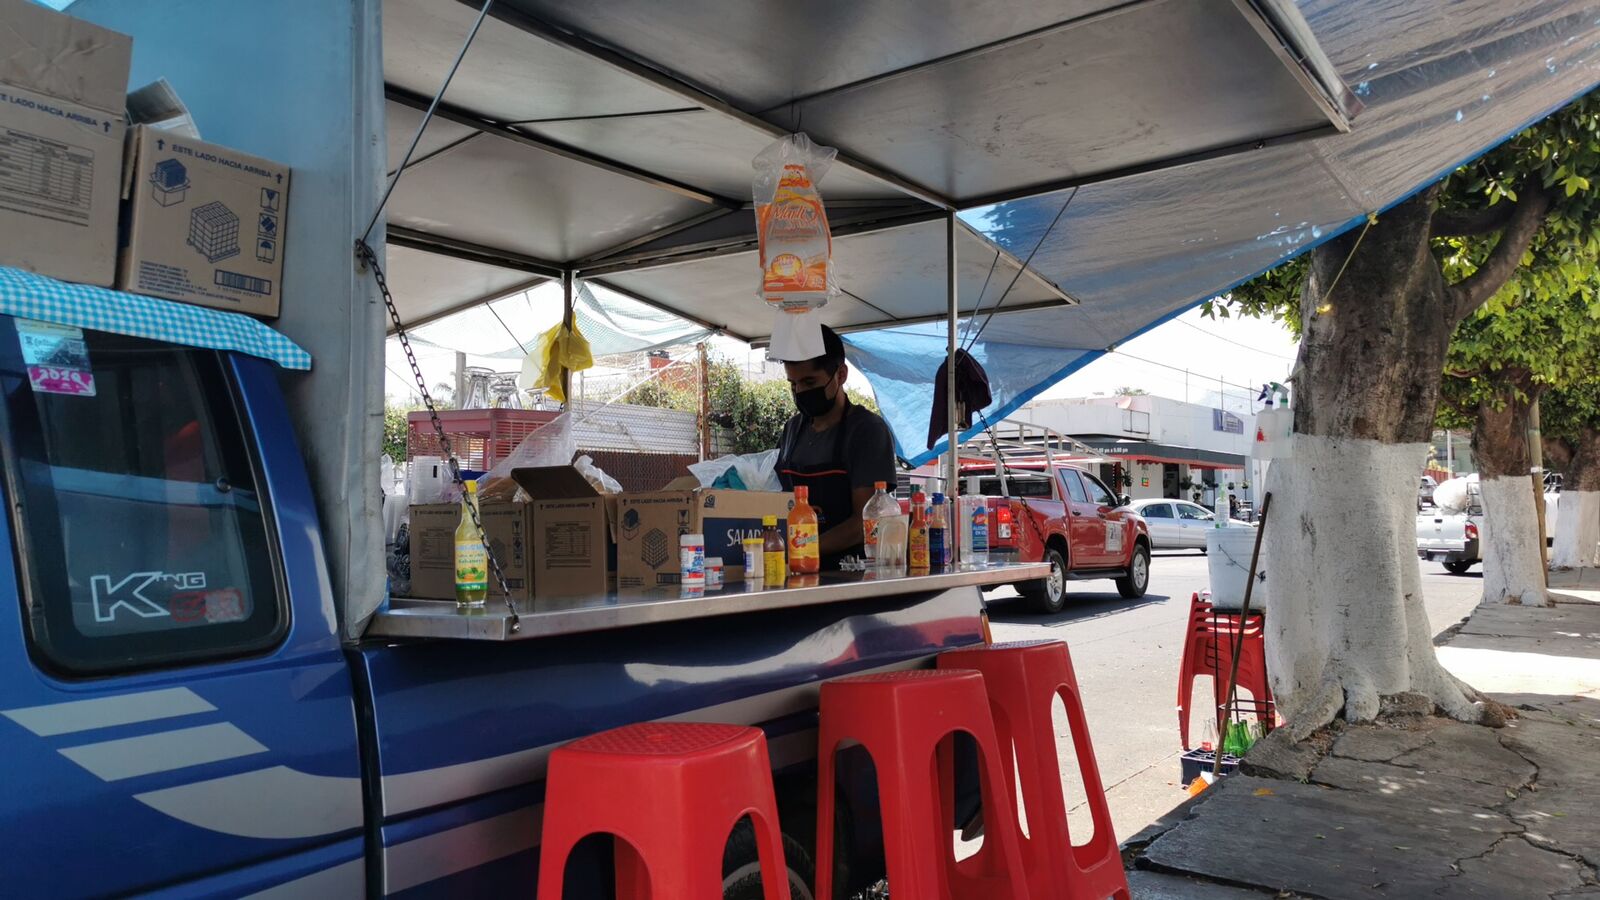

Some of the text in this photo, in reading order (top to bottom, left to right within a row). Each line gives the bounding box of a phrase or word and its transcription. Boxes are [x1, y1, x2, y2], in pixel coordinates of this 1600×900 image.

[10, 96, 35, 108] LADO
[37, 103, 64, 117] HACIA
[65, 112, 98, 126] ARRIBA
[172, 144, 272, 178] ESTE LADO HACIA ARRIBA
